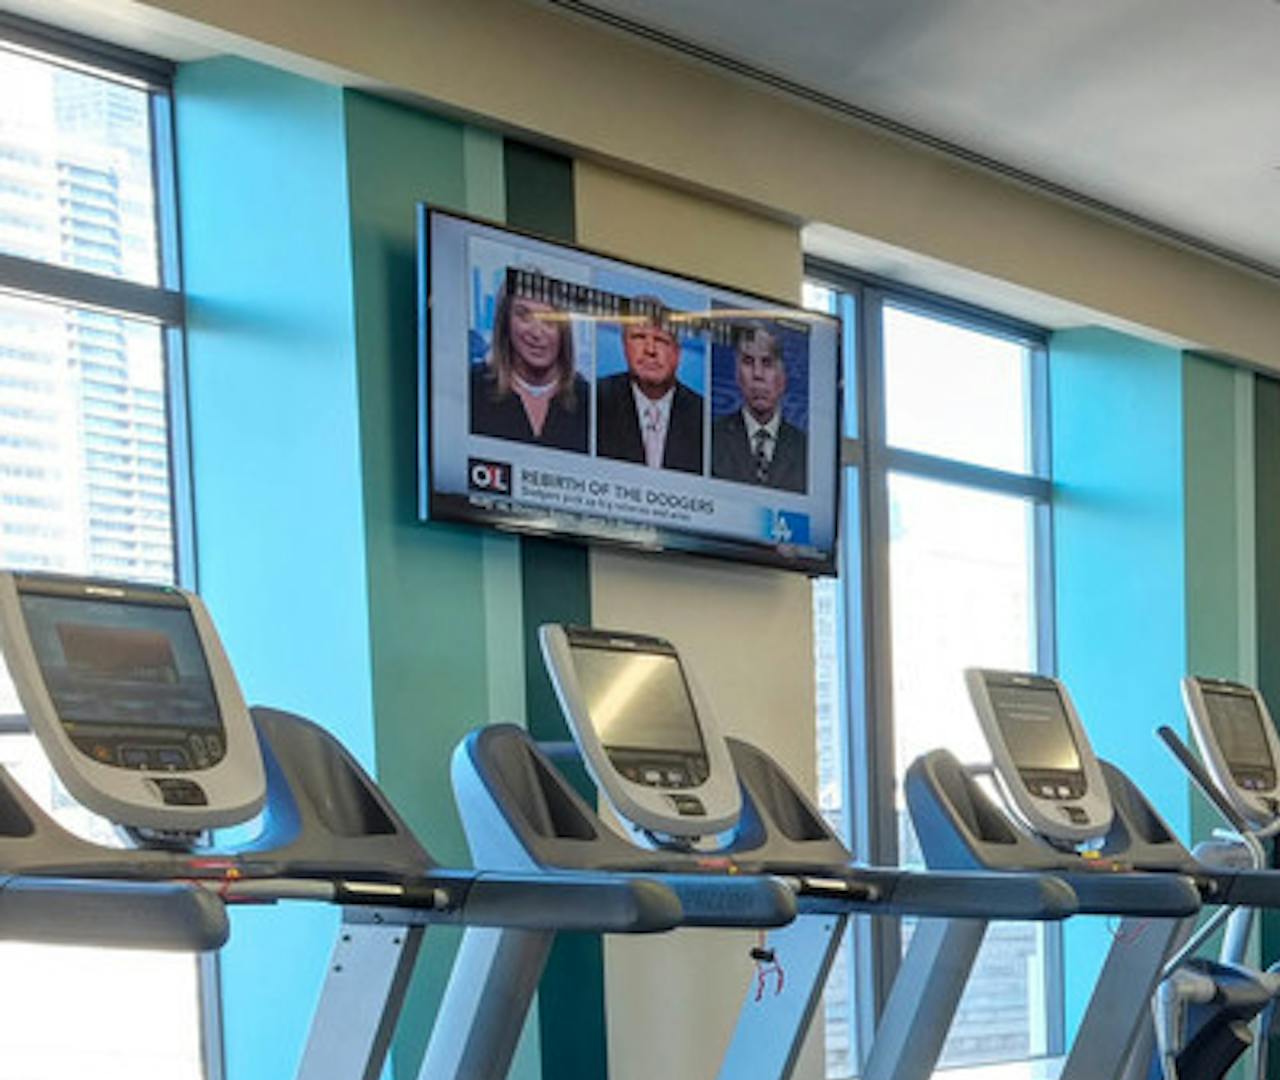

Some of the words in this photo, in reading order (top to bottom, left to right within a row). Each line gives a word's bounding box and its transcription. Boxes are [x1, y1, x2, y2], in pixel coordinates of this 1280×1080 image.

[522, 468, 586, 493] REBIRTH
[588, 479, 609, 496] OF
[615, 485, 642, 502] THE
[645, 491, 715, 514] DODGERS
